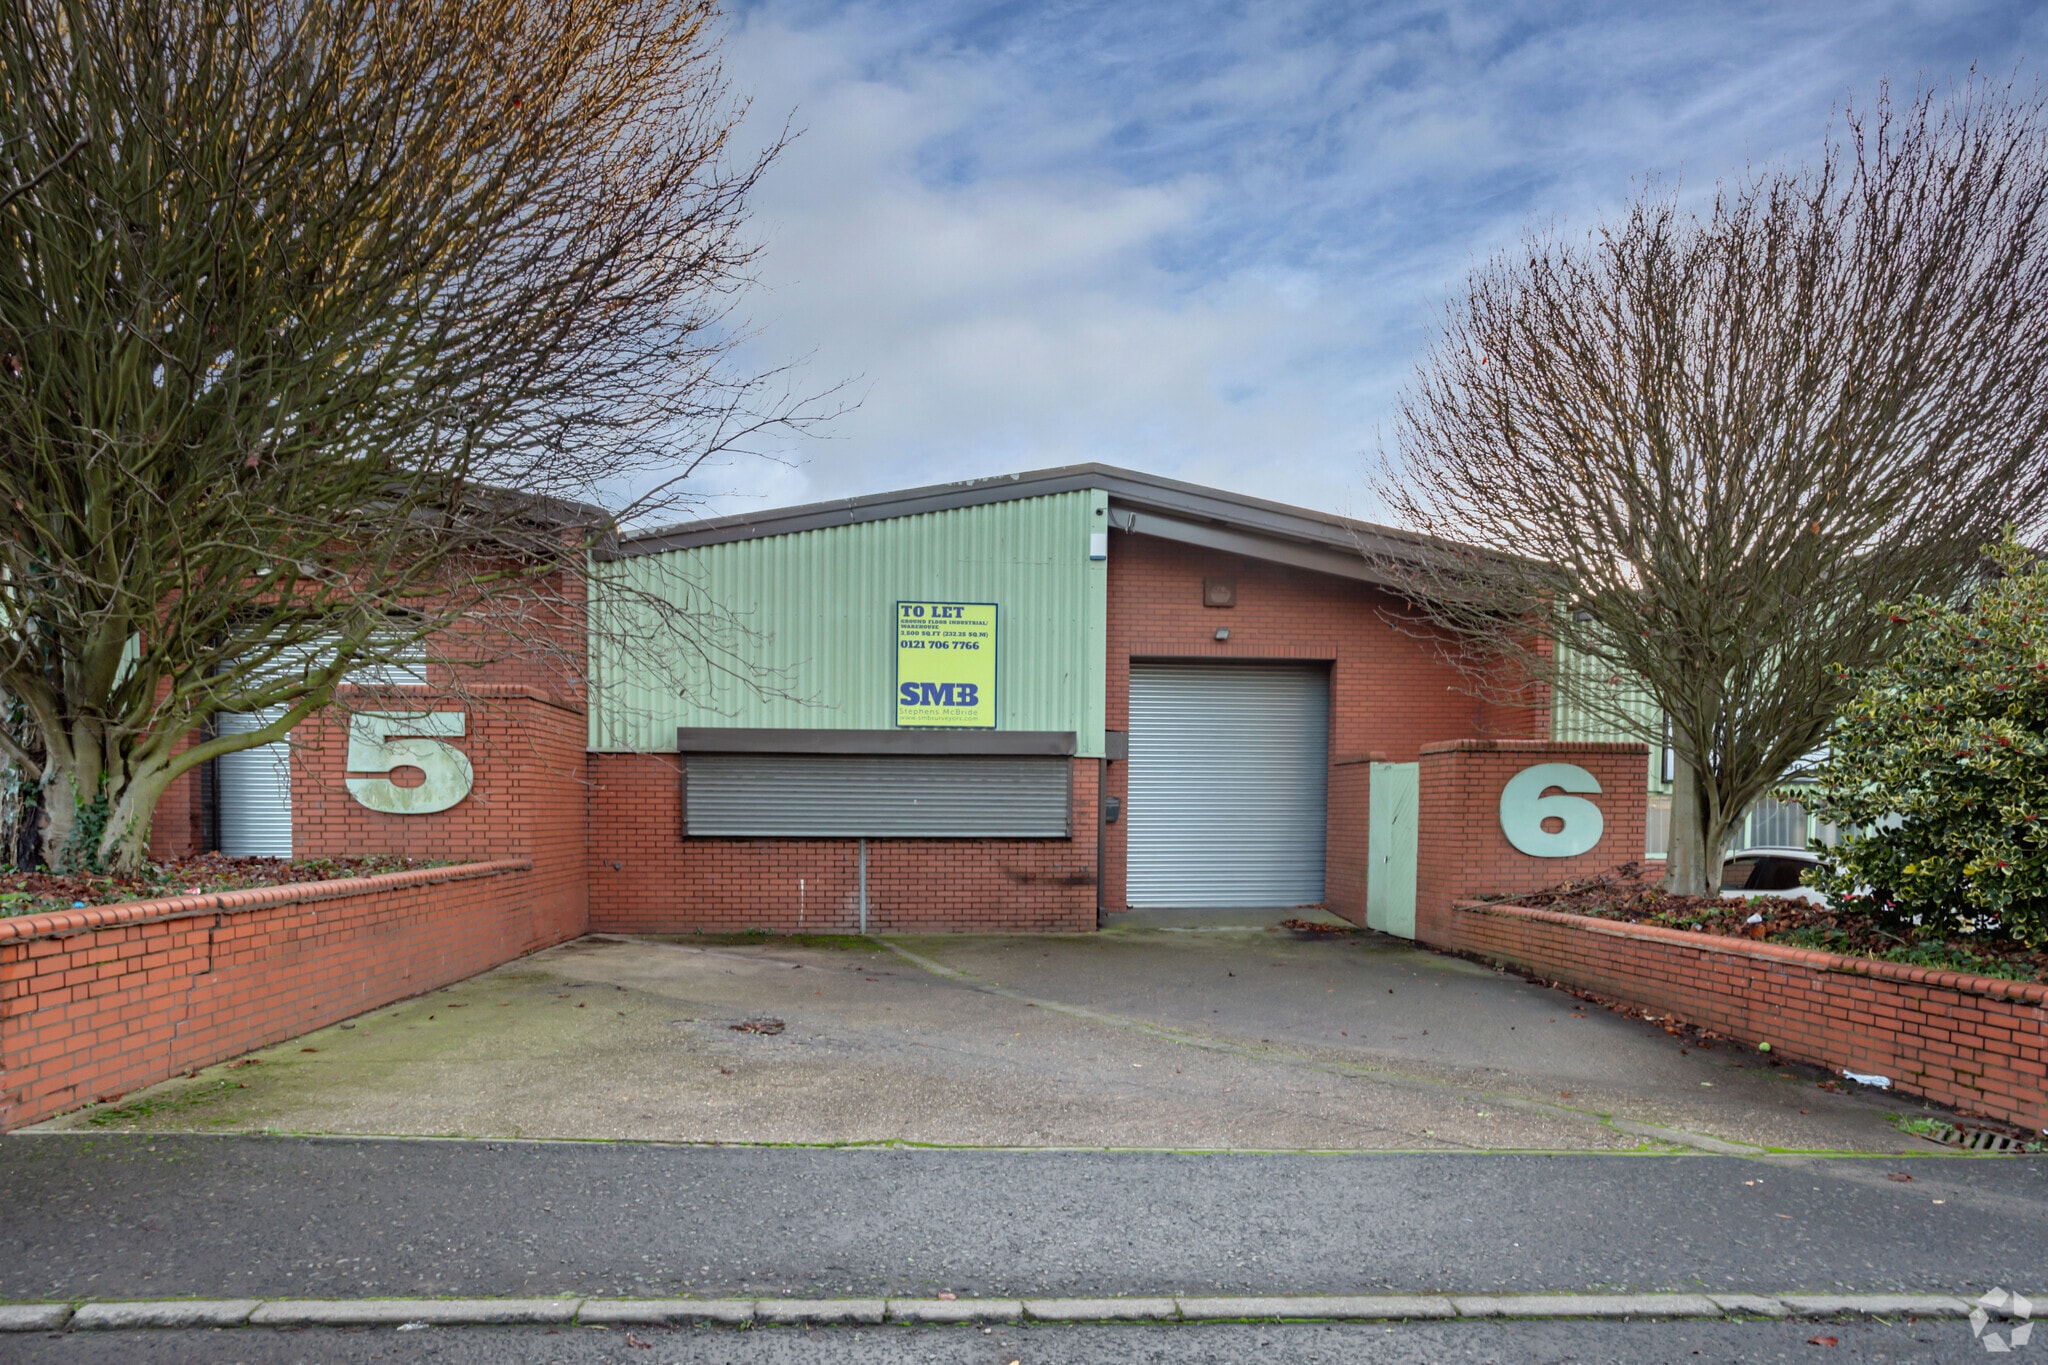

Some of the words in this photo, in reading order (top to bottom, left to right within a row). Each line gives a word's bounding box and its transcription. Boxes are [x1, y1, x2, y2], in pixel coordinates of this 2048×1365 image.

[901, 605, 925, 617] TO
[932, 606, 965, 618] LET
[900, 640, 925, 649] 0121
[928, 641, 949, 649] 706
[952, 641, 979, 650] 7766
[900, 681, 979, 707] SMB
[345, 711, 474, 815] 5
[1499, 762, 1604, 858] 6
